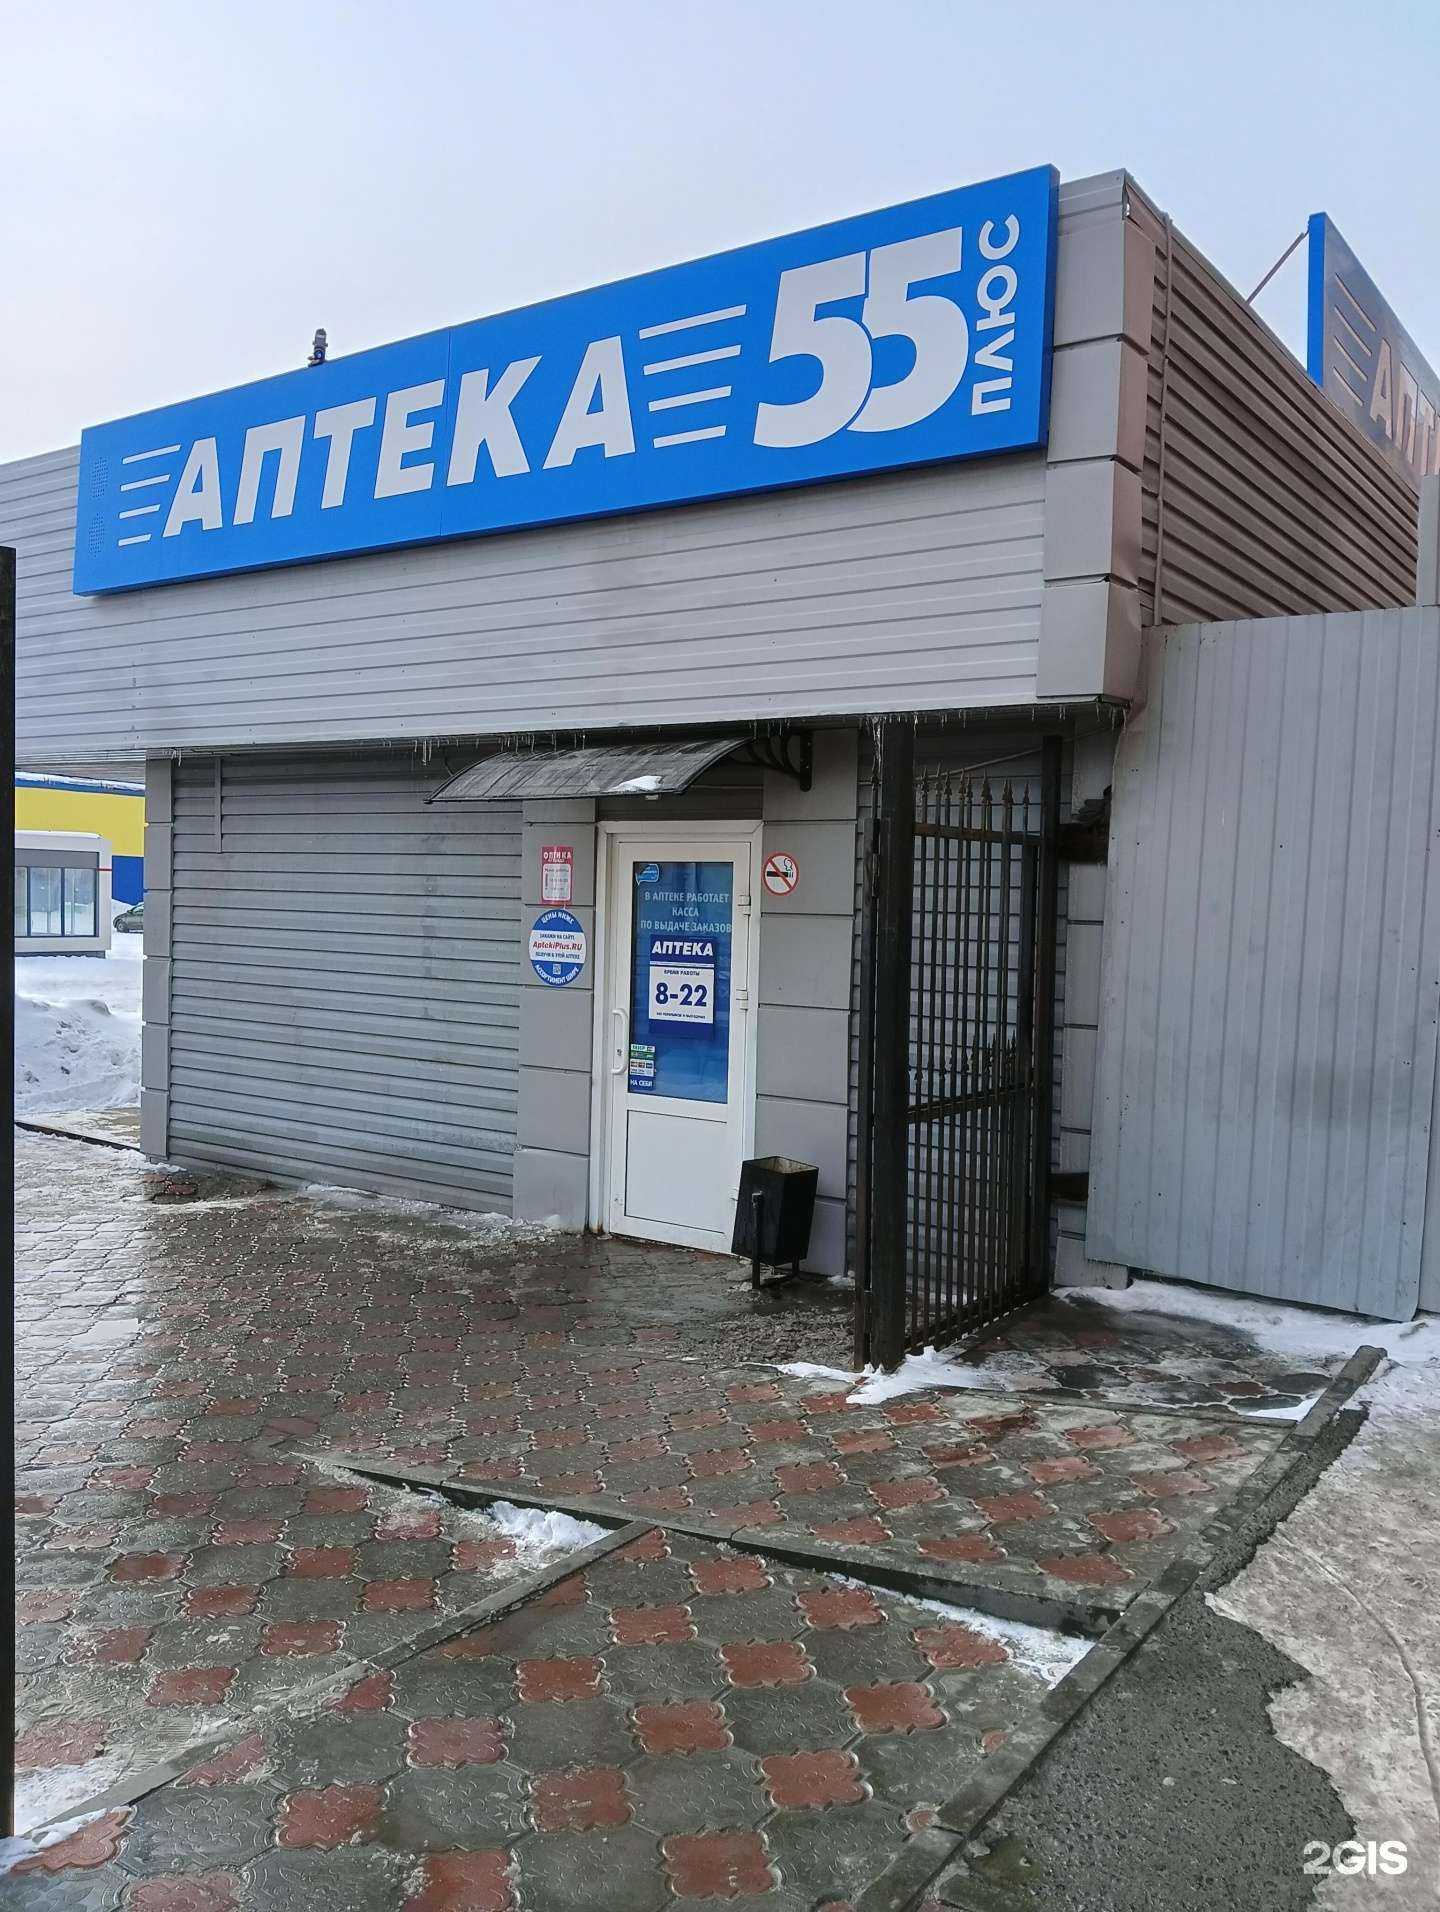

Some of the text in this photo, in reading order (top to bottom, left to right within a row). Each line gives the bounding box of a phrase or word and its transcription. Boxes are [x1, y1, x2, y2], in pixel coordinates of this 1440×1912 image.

[970, 213, 1021, 416] ПЛЮС
[162, 226, 971, 538] АПТЕКА 55
[1369, 336, 1440, 476] АПТ
[543, 851, 572, 860] ОПТИКА
[644, 891, 730, 903] В АПТЕКЕ РАБОТАЕТ
[541, 911, 557, 924] ЦЕНЫ
[672, 907, 700, 917] КАССА
[640, 920, 732, 933] ПО ВЫДАЧЕ ЗАКАЗОВ
[651, 941, 714, 957] АПТЕКА
[655, 982, 708, 1007] 8-22
